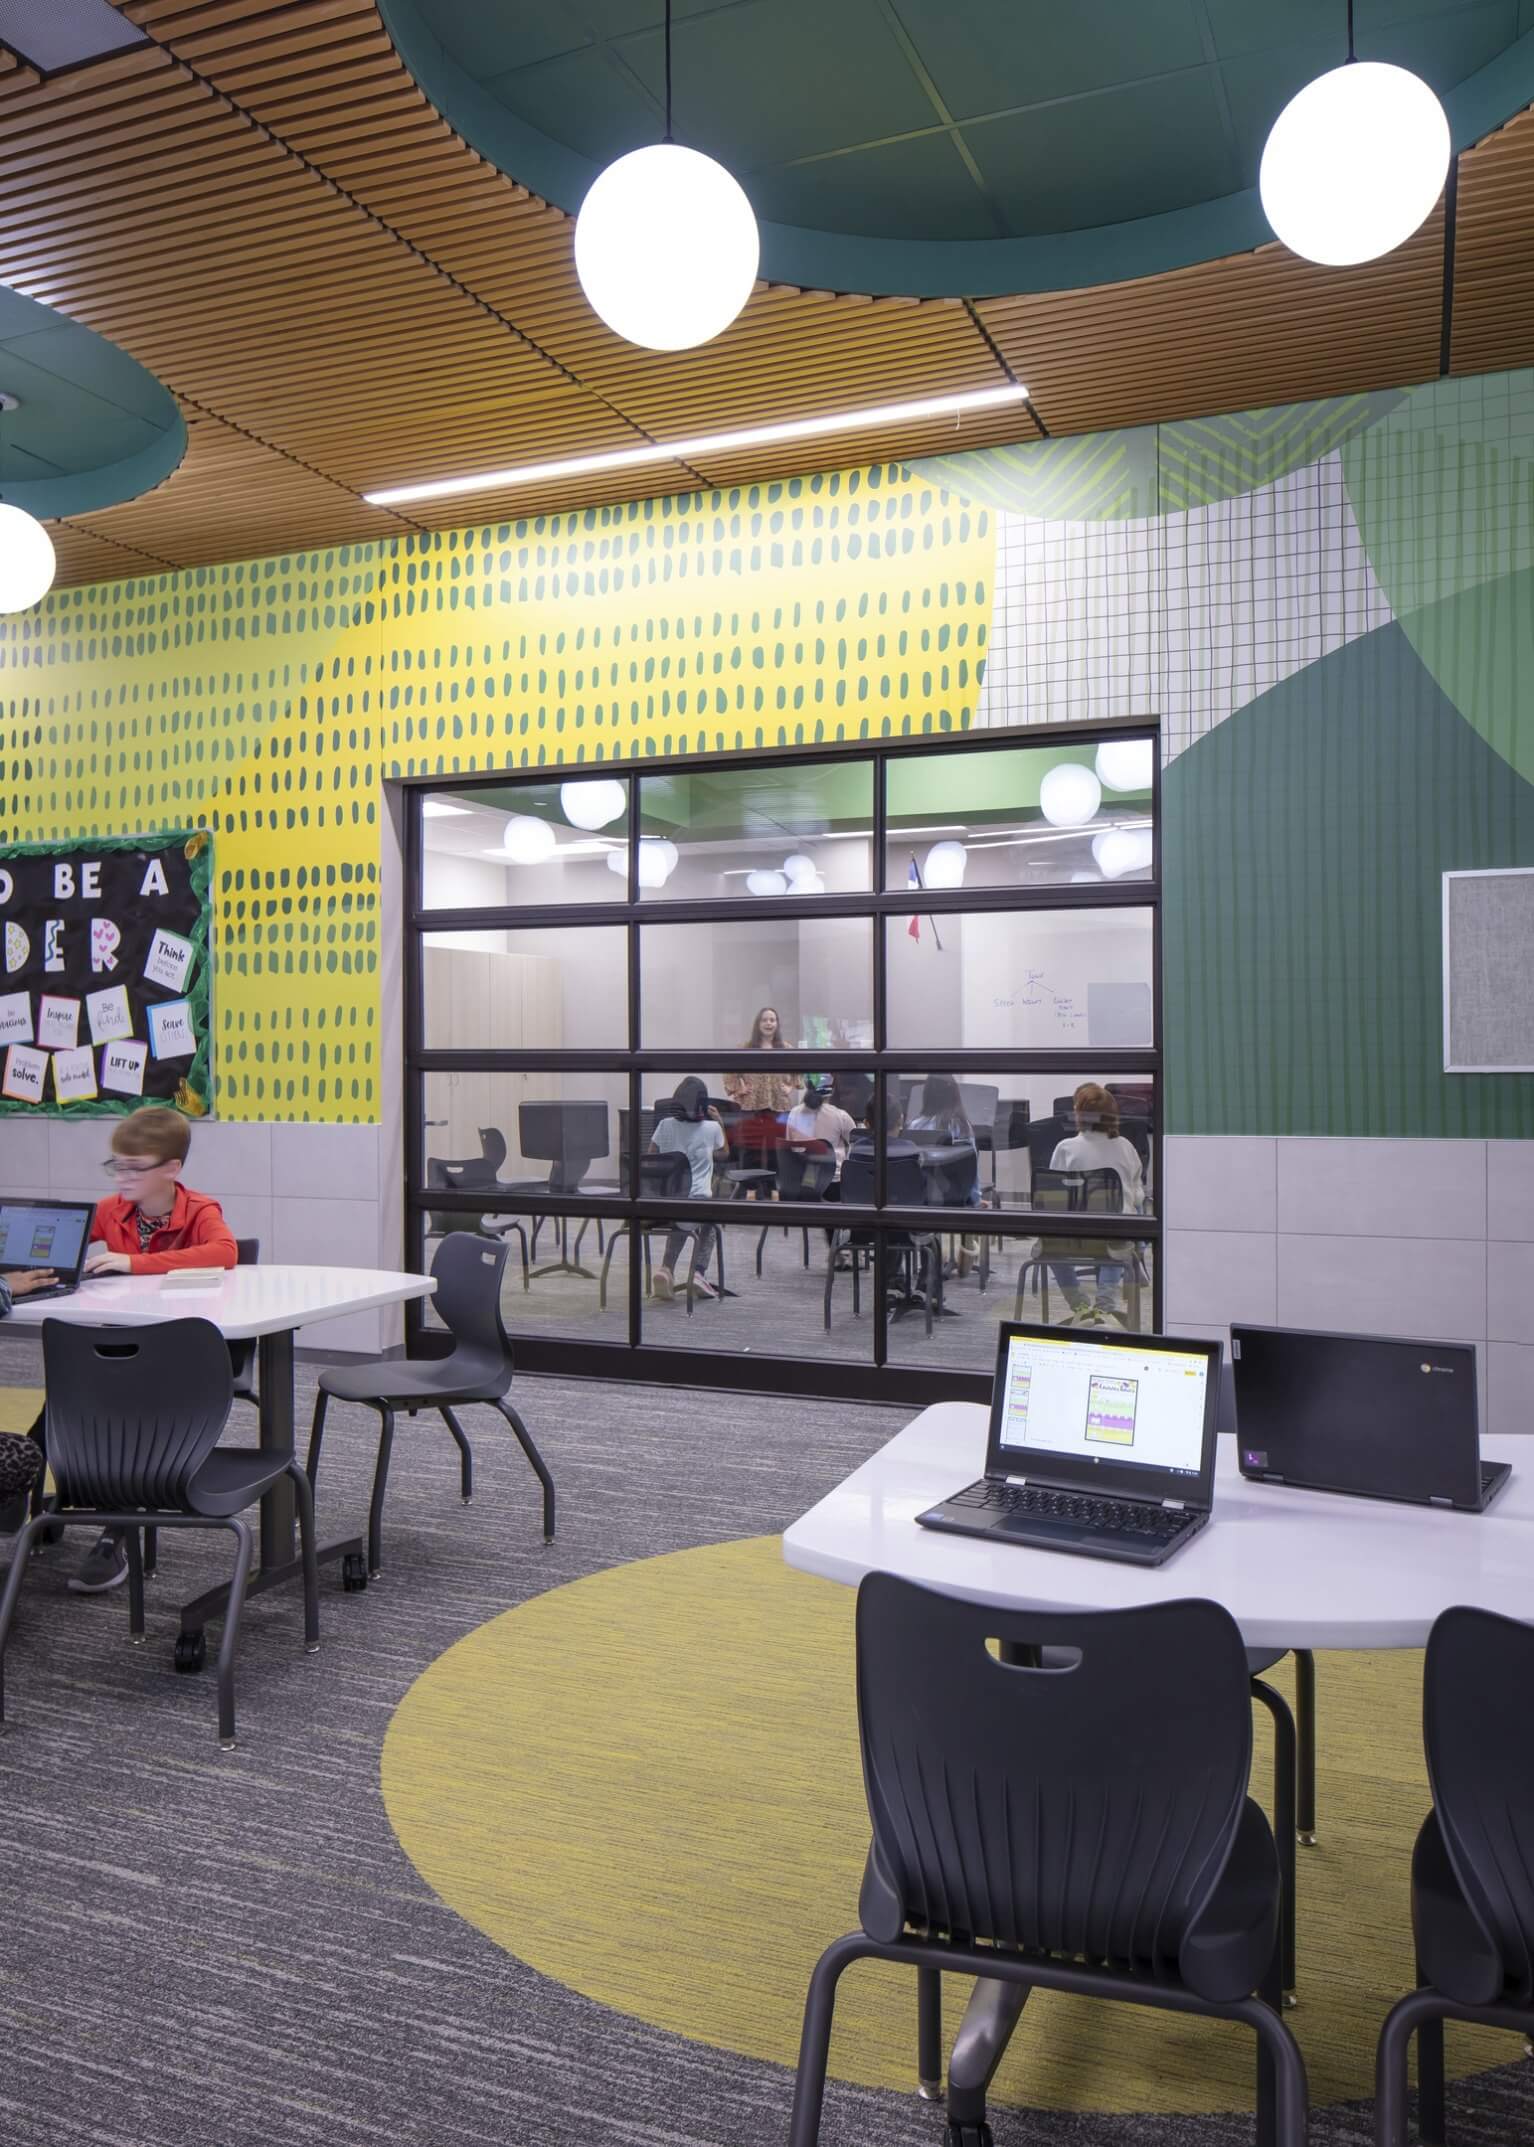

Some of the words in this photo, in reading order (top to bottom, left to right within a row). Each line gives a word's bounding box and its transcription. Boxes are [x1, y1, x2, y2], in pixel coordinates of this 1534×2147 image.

[54, 861, 103, 899] BE
[139, 858, 169, 897] A
[158, 940, 185, 963] Think
[110, 1056, 128, 1069] LIFT
[128, 1060, 140, 1071] UP
[13, 1067, 39, 1085] solve.
